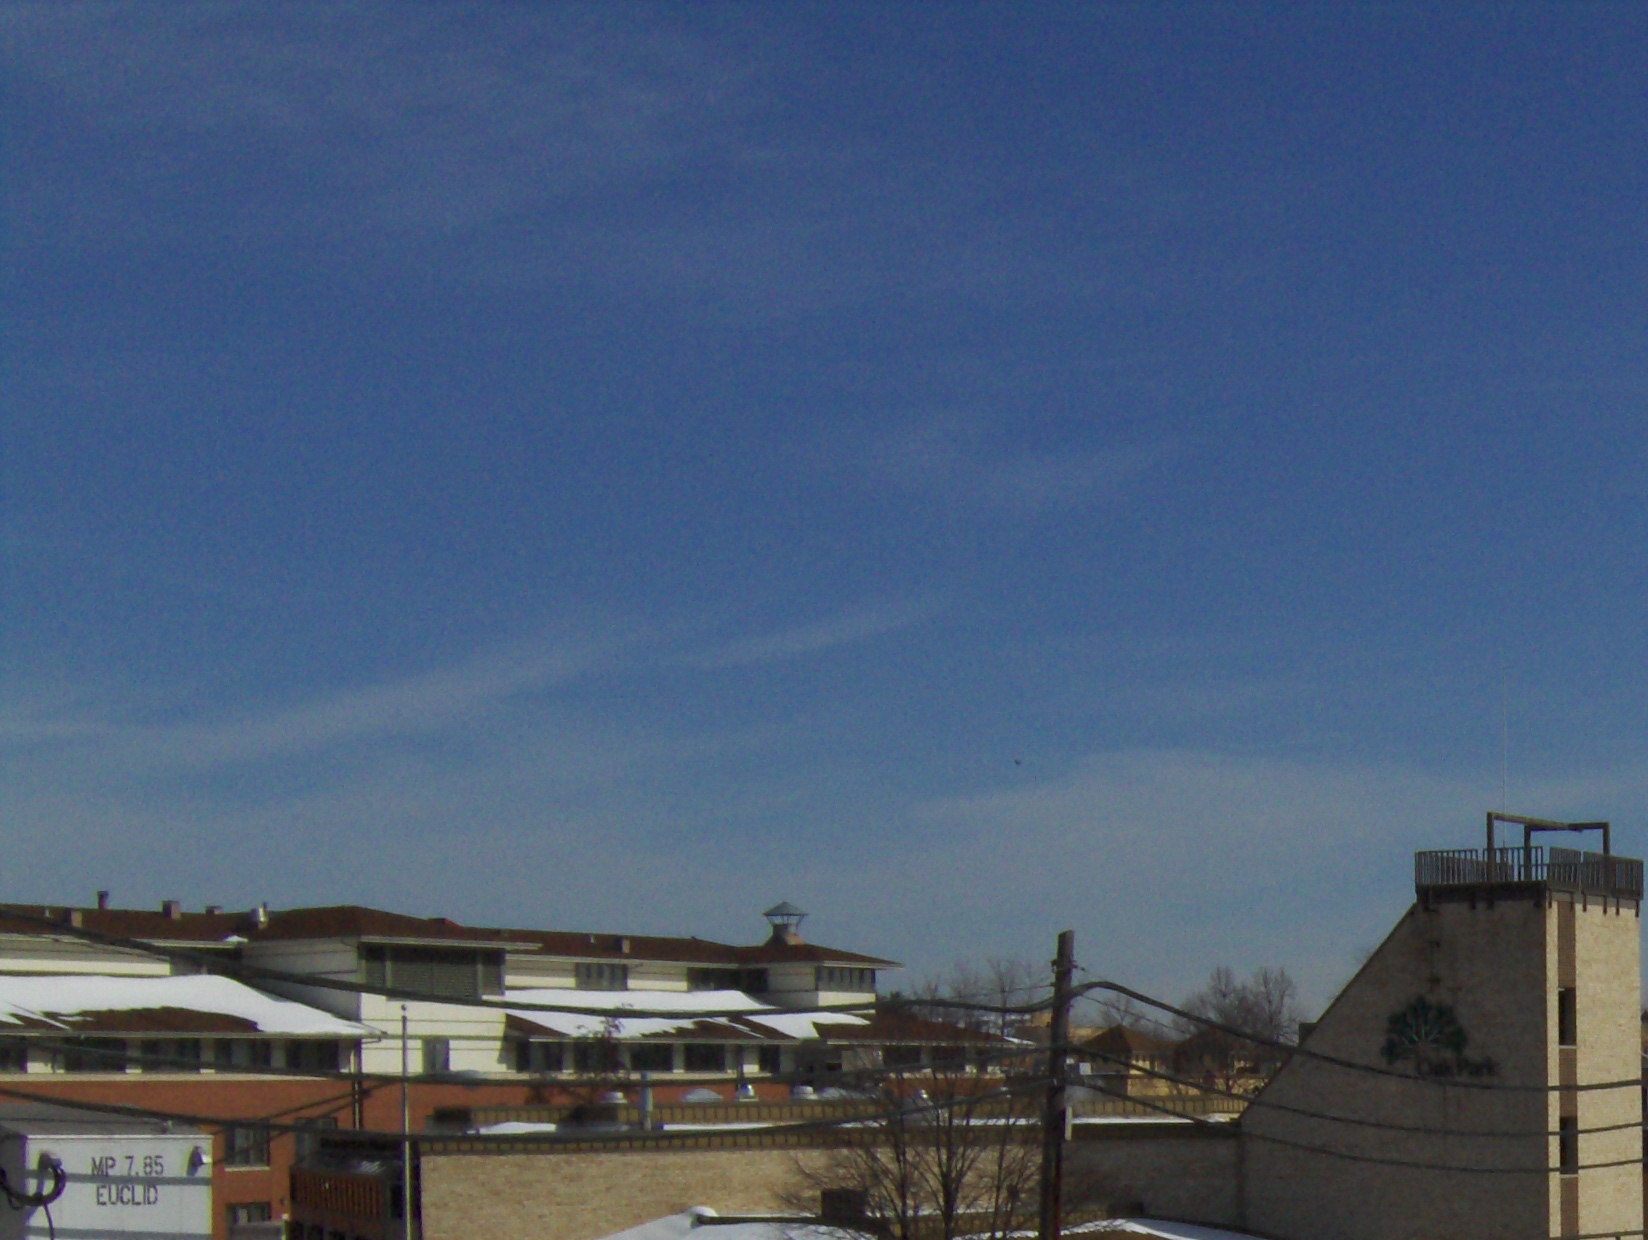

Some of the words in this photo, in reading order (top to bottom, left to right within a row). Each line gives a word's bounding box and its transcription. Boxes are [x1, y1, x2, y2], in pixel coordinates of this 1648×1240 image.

[91, 1156, 116, 1177] MP
[124, 1155, 164, 1177] 7.85
[96, 1184, 158, 1206] EUCLID
